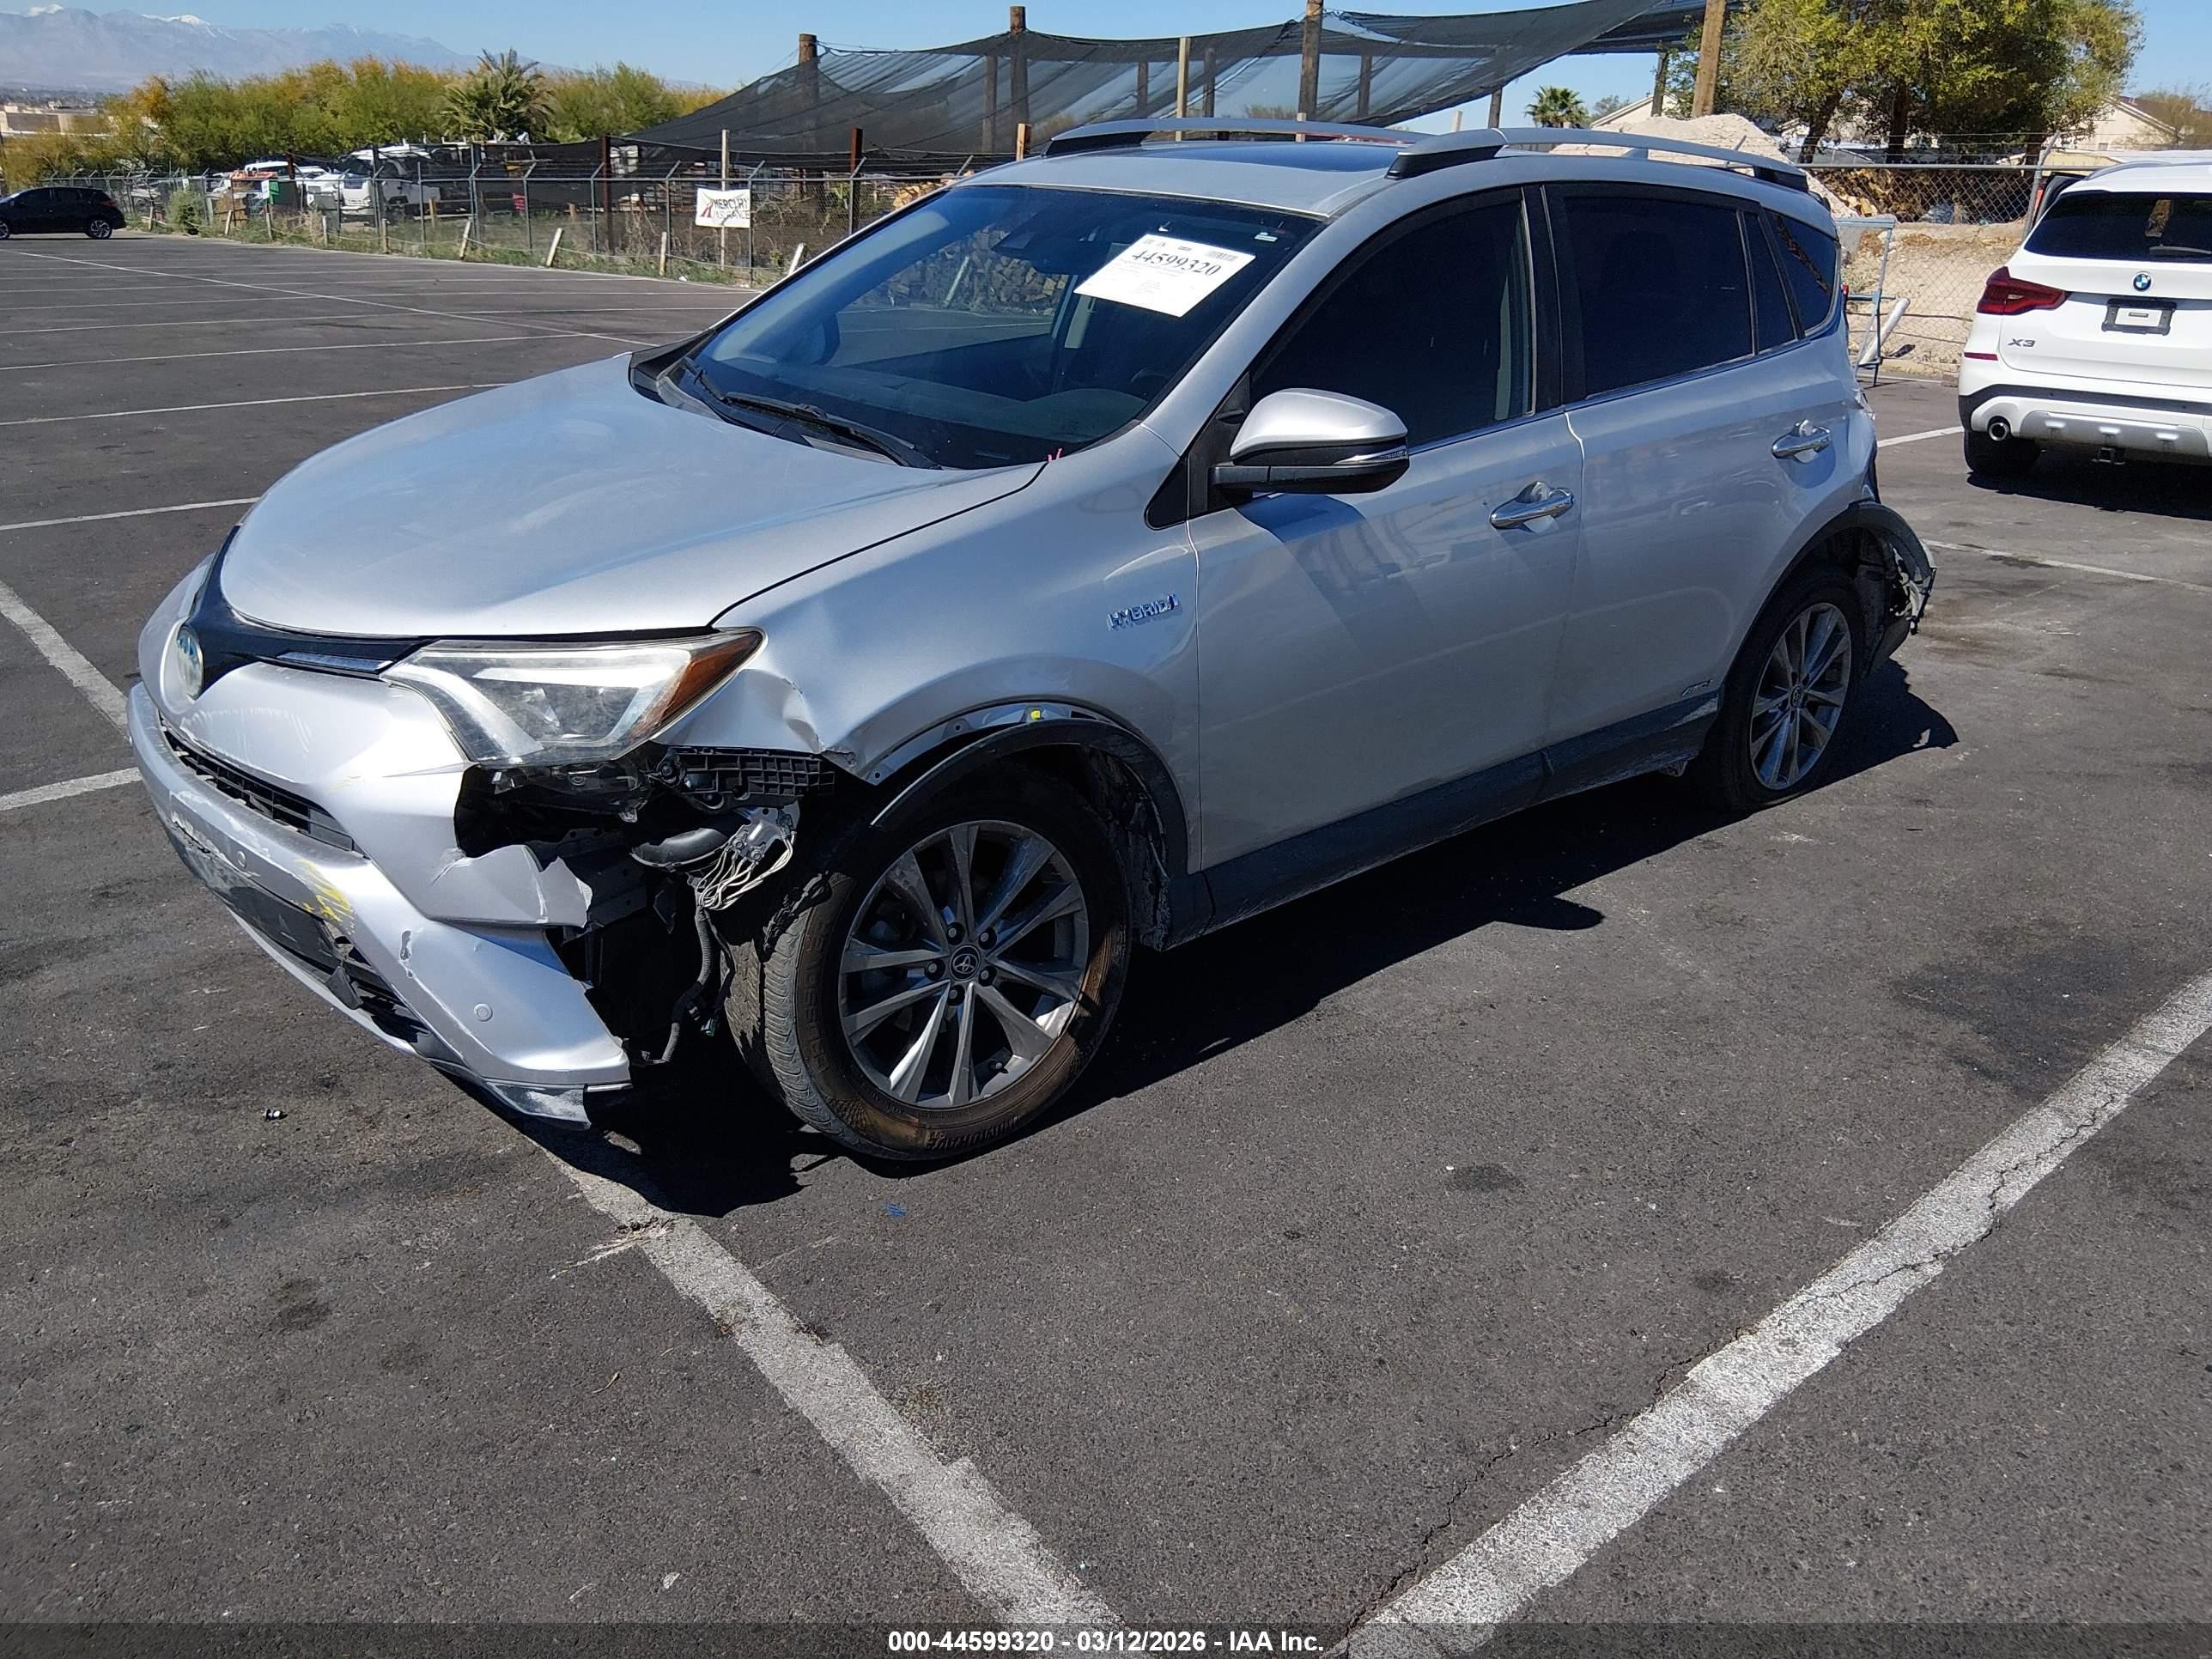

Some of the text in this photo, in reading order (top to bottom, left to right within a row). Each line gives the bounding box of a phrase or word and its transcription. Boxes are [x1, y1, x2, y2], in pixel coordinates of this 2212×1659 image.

[1131, 249, 1223, 276] 44599320
[2007, 337, 2036, 348] X3
[1107, 593, 1179, 628] HYBRID
